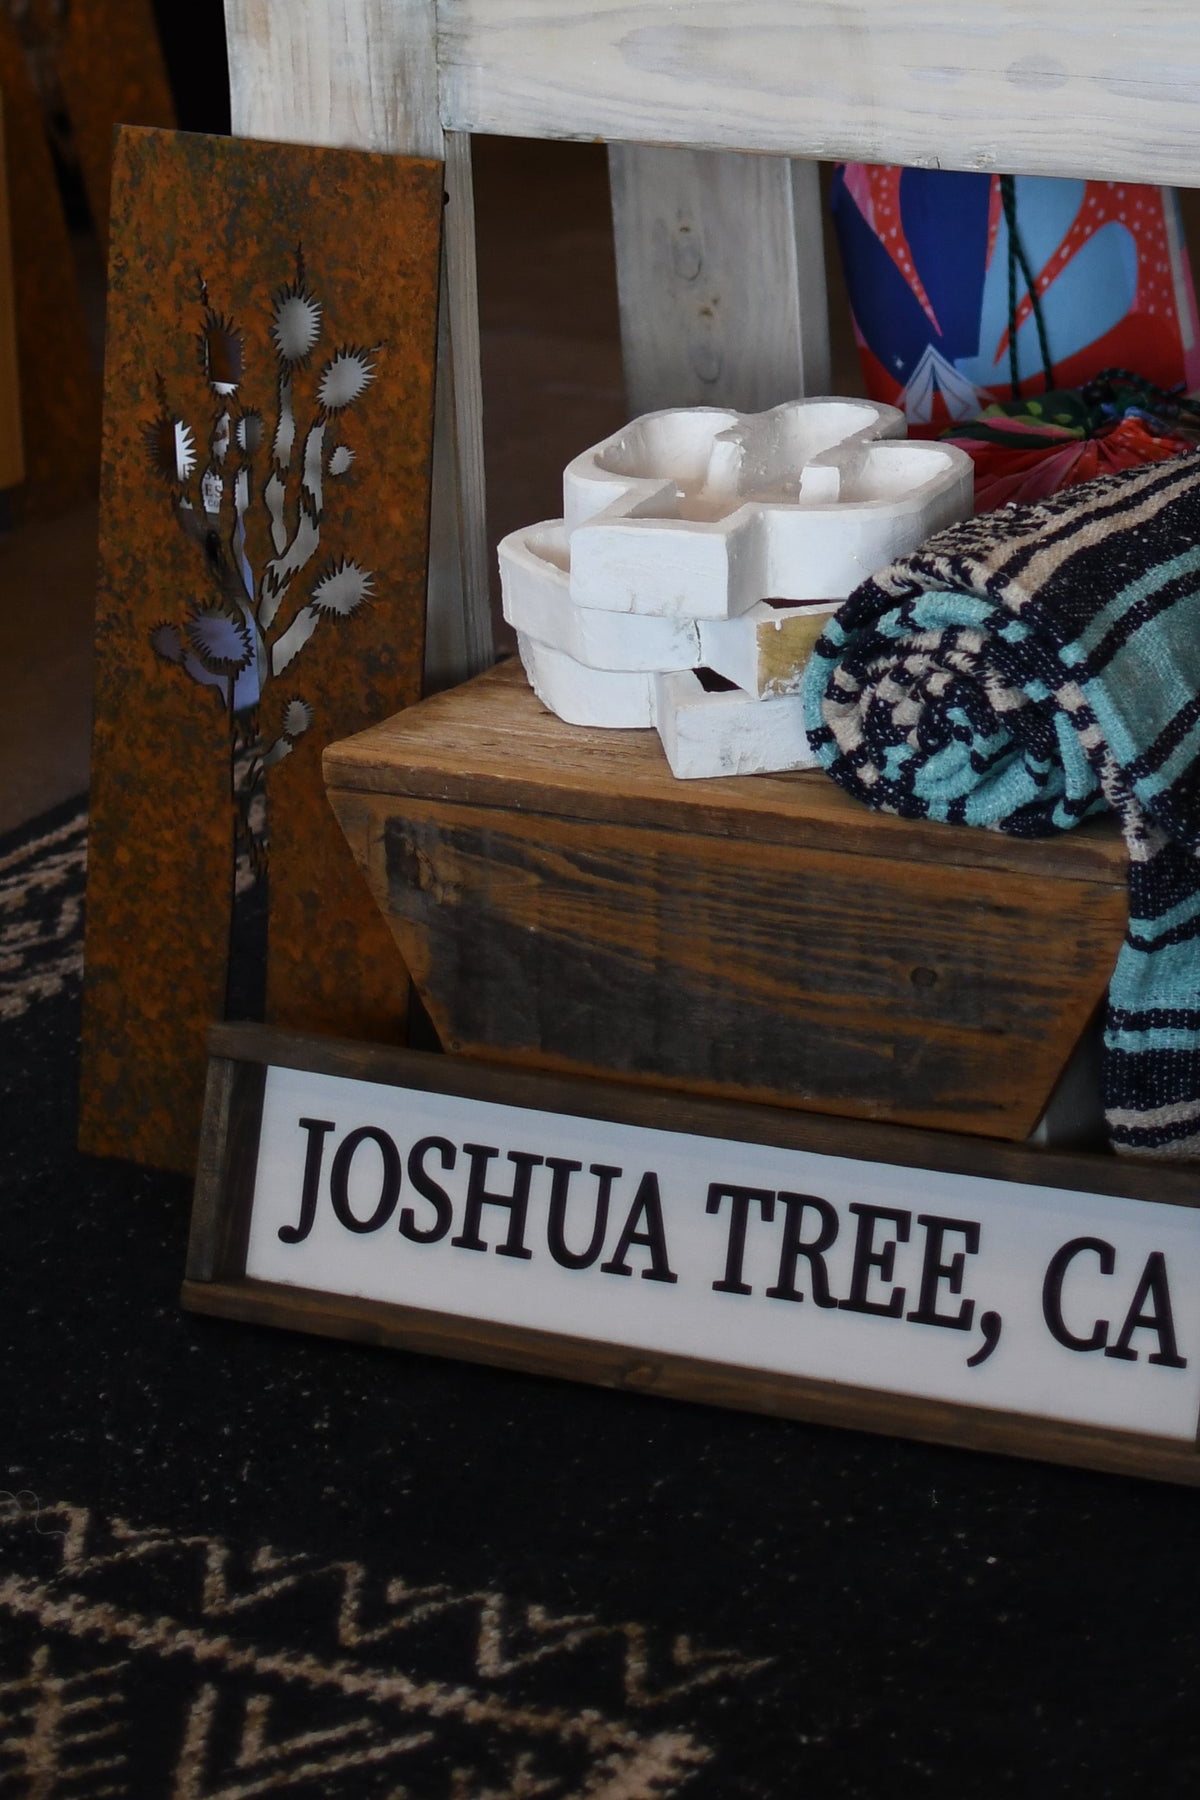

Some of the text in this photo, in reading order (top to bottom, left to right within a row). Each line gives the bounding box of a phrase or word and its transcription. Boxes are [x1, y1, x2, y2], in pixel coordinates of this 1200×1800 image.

[278, 1117, 1188, 1369] JOSHUA TREE, CA
